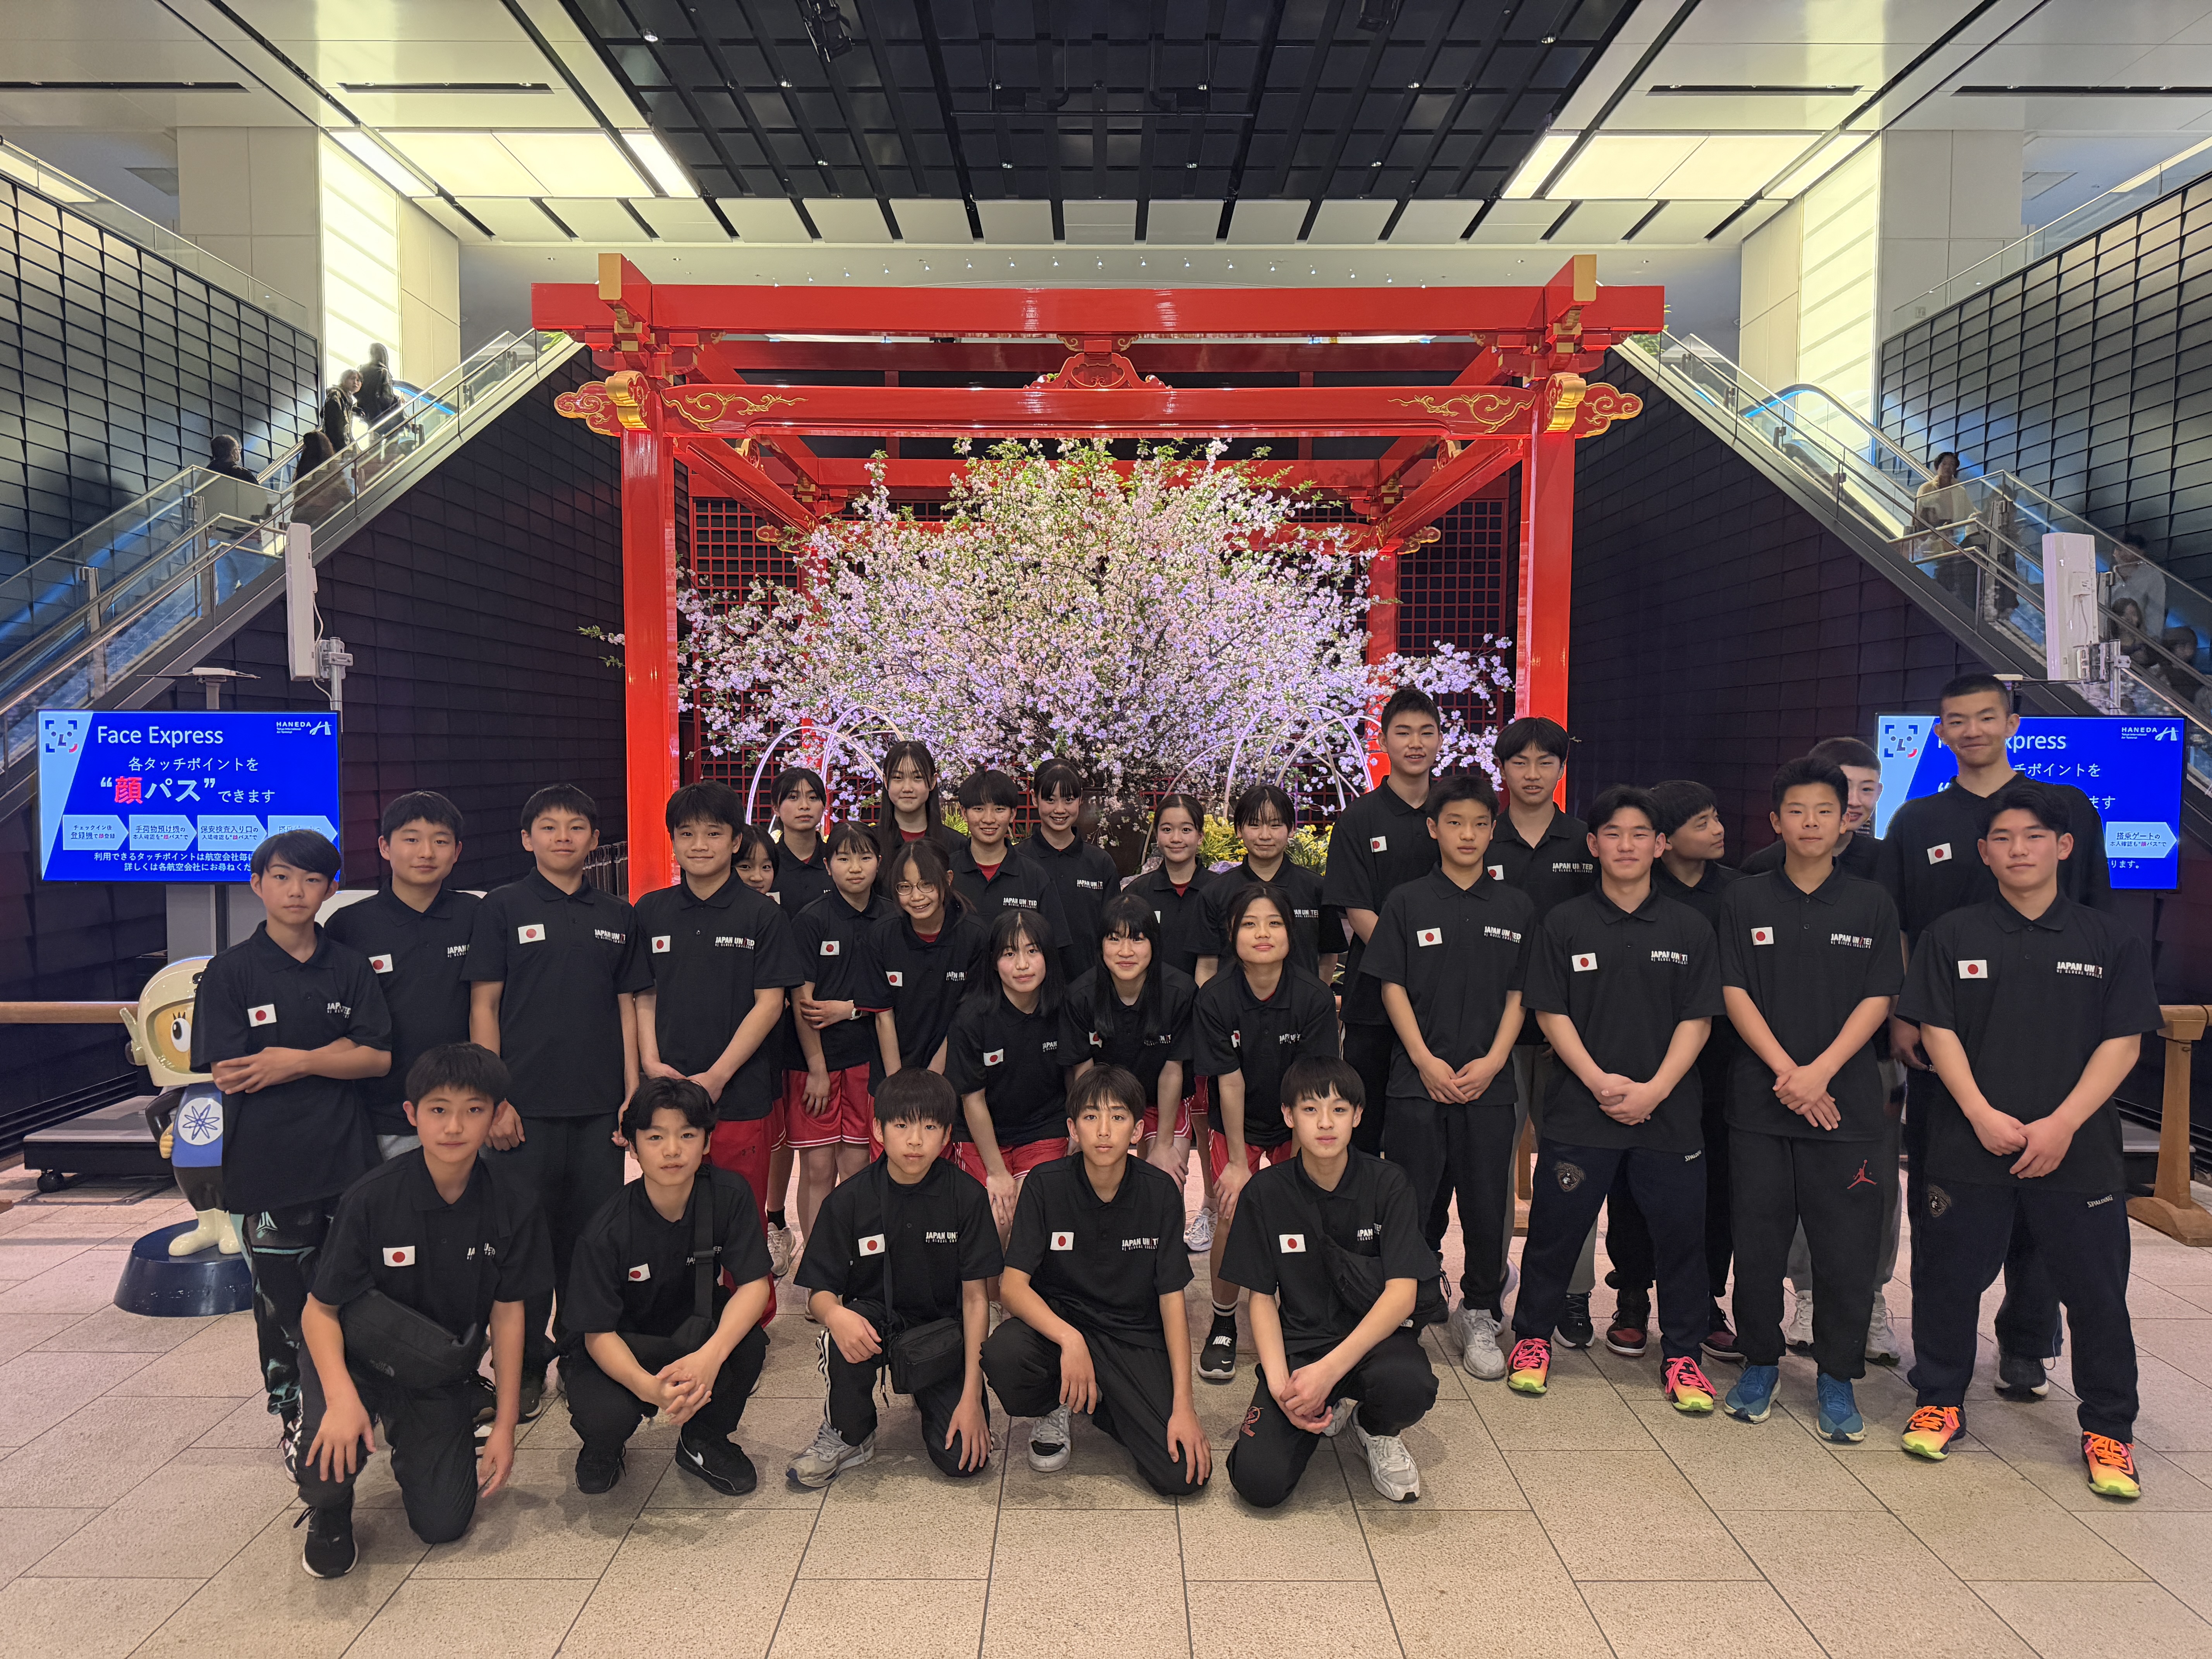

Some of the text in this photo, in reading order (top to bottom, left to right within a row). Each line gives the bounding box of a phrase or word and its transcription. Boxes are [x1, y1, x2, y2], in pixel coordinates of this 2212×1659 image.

[98, 726, 224, 748] Face Express
[2005, 735, 2066, 753] xpress
[128, 757, 259, 771] 各タッチポイントを
[594, 929, 611, 938] JAPAN
[1484, 926, 1501, 935] JAPAN
[1831, 933, 1851, 943] JAPAN
[447, 945, 467, 955] JAPAN
[2056, 962, 2083, 972] JAPAN
[2087, 1194, 2114, 1208] SPALDING
[926, 1232, 946, 1240] JAPAN
[1357, 1228, 1374, 1238] APAN
[1121, 1238, 1142, 1247] JAPAN
[1212, 1335, 1232, 1347] NIKE
